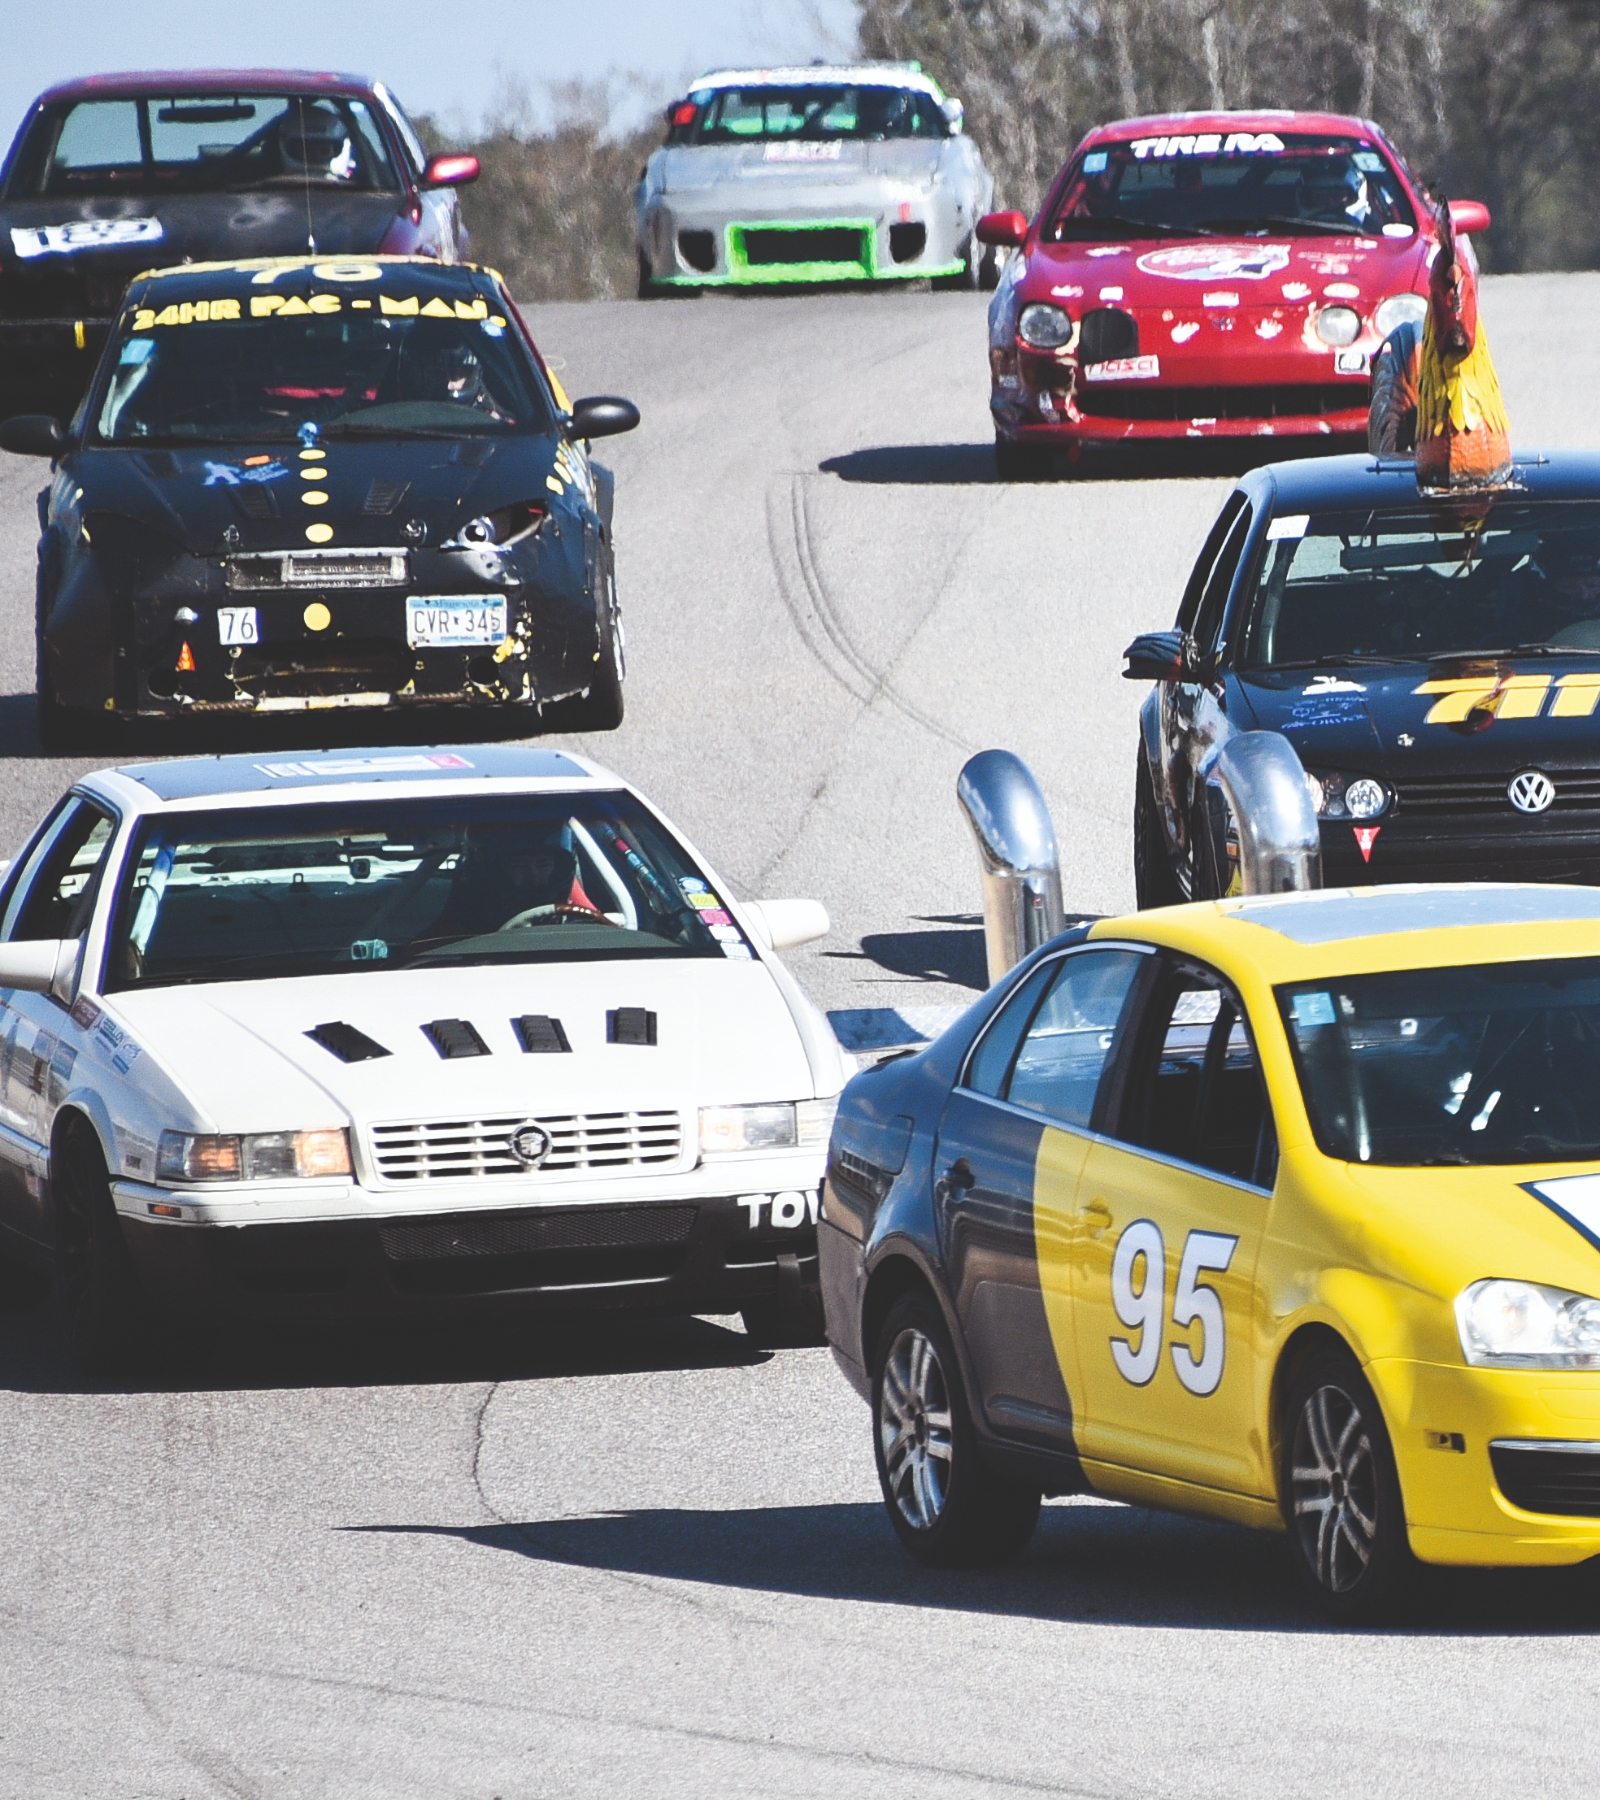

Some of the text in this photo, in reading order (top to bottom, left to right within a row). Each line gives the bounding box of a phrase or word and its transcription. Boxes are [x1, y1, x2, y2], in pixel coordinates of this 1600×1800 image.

[131, 299, 241, 331] 24HR
[220, 610, 254, 641] 76
[1108, 1217, 1240, 1398] 95
